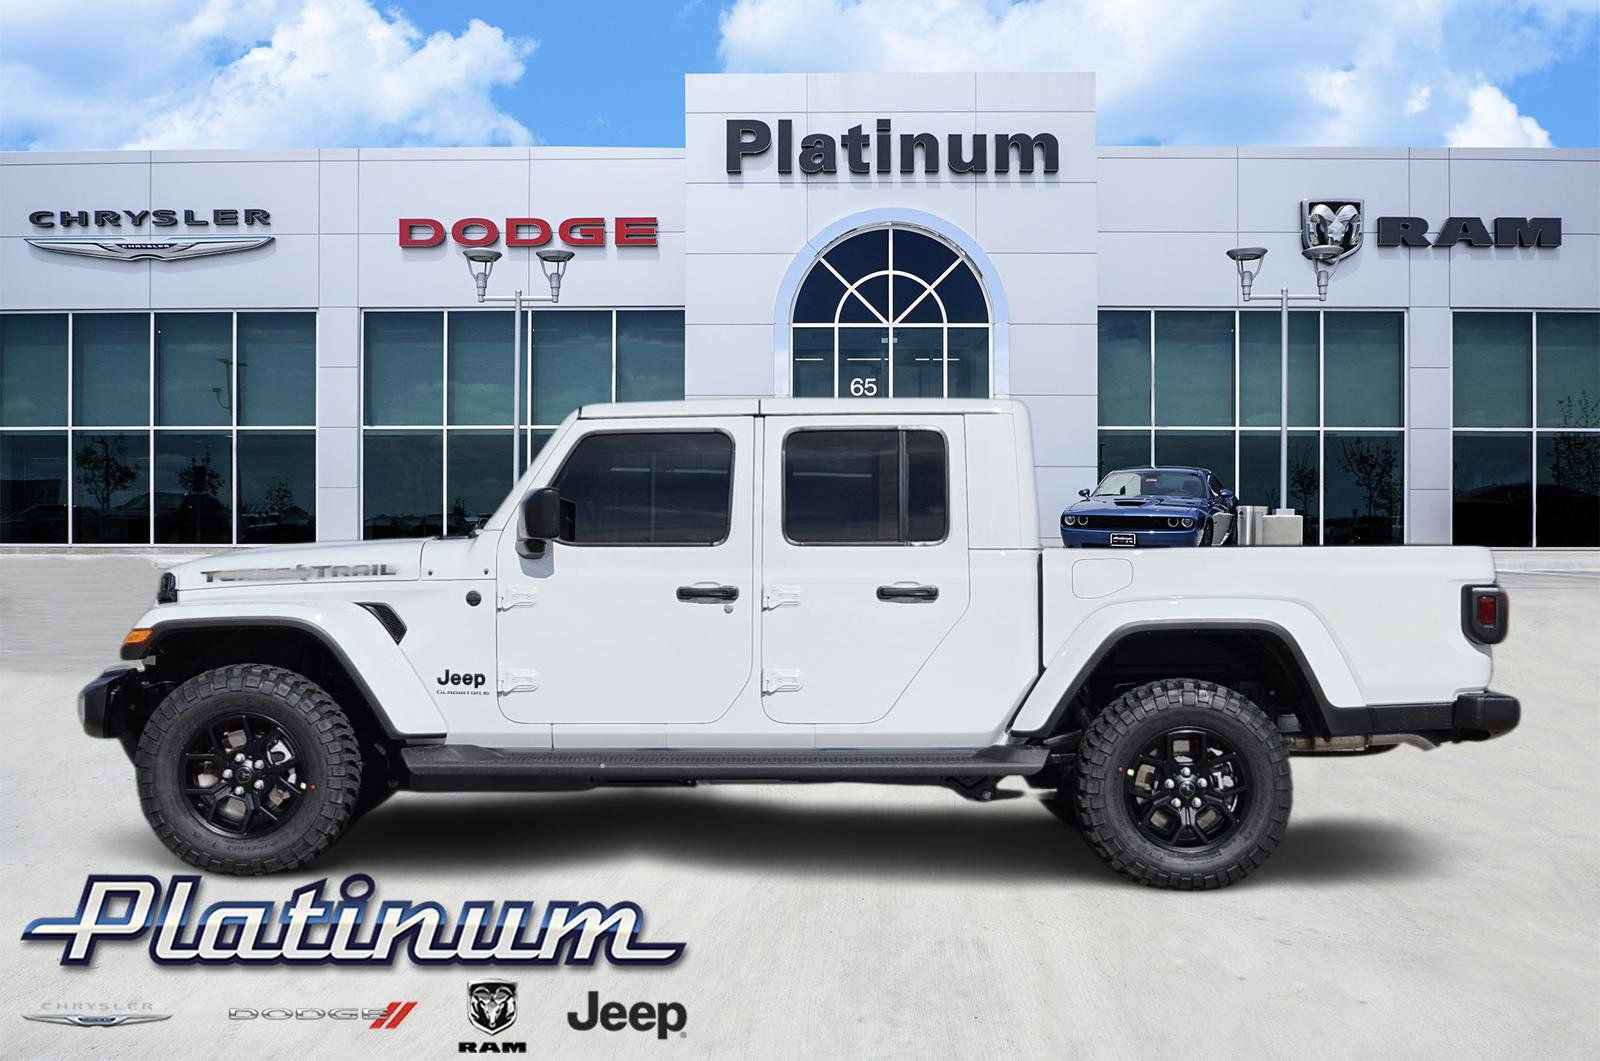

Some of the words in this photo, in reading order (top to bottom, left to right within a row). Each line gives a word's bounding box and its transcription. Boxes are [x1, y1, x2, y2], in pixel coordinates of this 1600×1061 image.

[726, 118, 1060, 175] Platinum
[29, 209, 272, 228] CHRYSLER
[398, 216, 658, 248] DODGE
[1376, 216, 1562, 249] RAM
[850, 377, 878, 397] 65
[310, 564, 397, 578] TRAIL
[436, 669, 486, 689] Jeep
